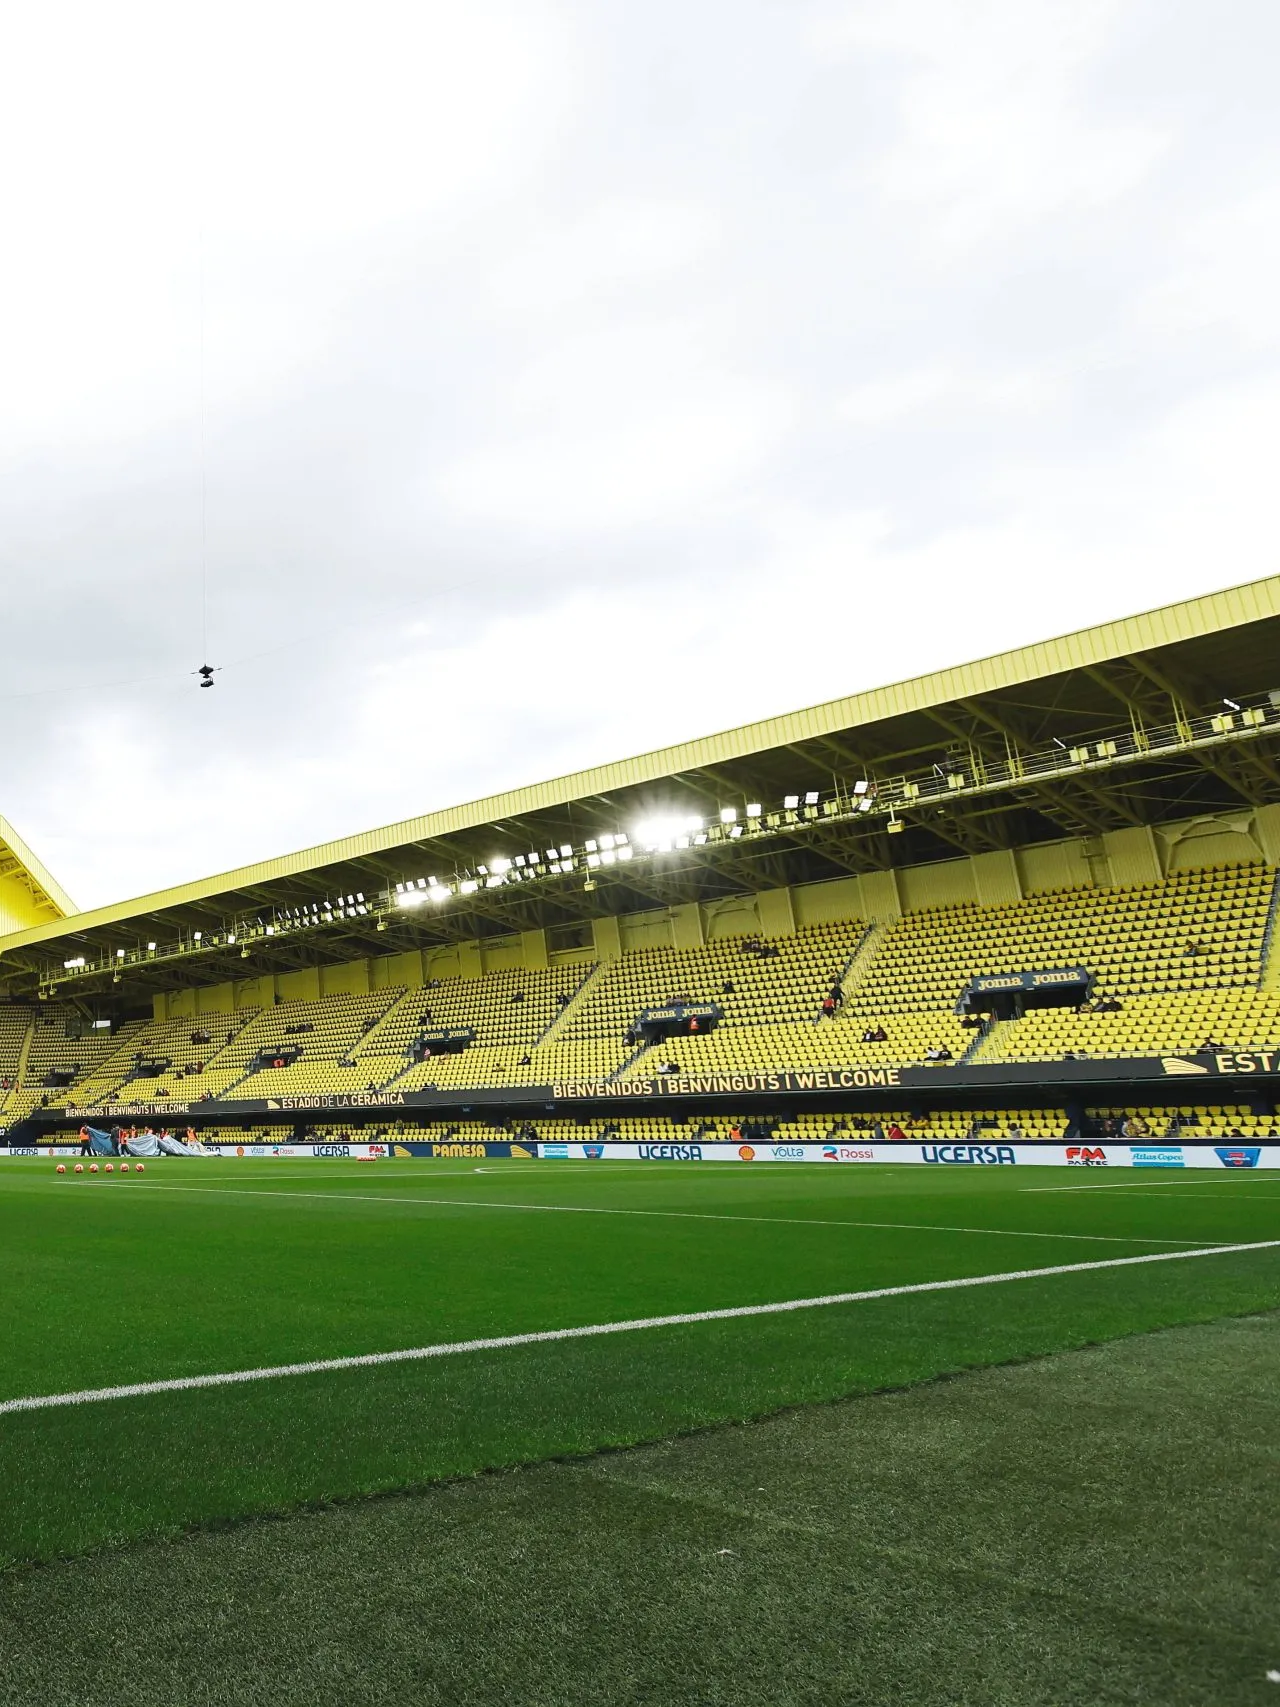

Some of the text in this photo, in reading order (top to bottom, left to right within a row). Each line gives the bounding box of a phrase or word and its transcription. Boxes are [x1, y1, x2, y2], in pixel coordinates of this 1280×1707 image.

[1215, 1052, 1280, 1073] EST
[553, 1069, 901, 1099] BIENVENIDOS BENVINGUTS WELCOME
[282, 1096, 320, 1109] ESTADIO
[321, 1096, 334, 1108] DE
[336, 1096, 350, 1107] LA
[65, 1103, 190, 1118] BIENVENIDOS BENVINGUTS WELCOME
[10, 1148, 39, 1156] UCERSA
[313, 1145, 350, 1157] UCERSA
[432, 1145, 486, 1157] PAMESA
[638, 1145, 702, 1160] UCERSA
[771, 1146, 804, 1157] Volta
[840, 1148, 874, 1159] Rossi
[921, 1146, 1016, 1165] UCERSA
[1066, 1147, 1107, 1160] FM
[1157, 1153, 1184, 1161] Copco
